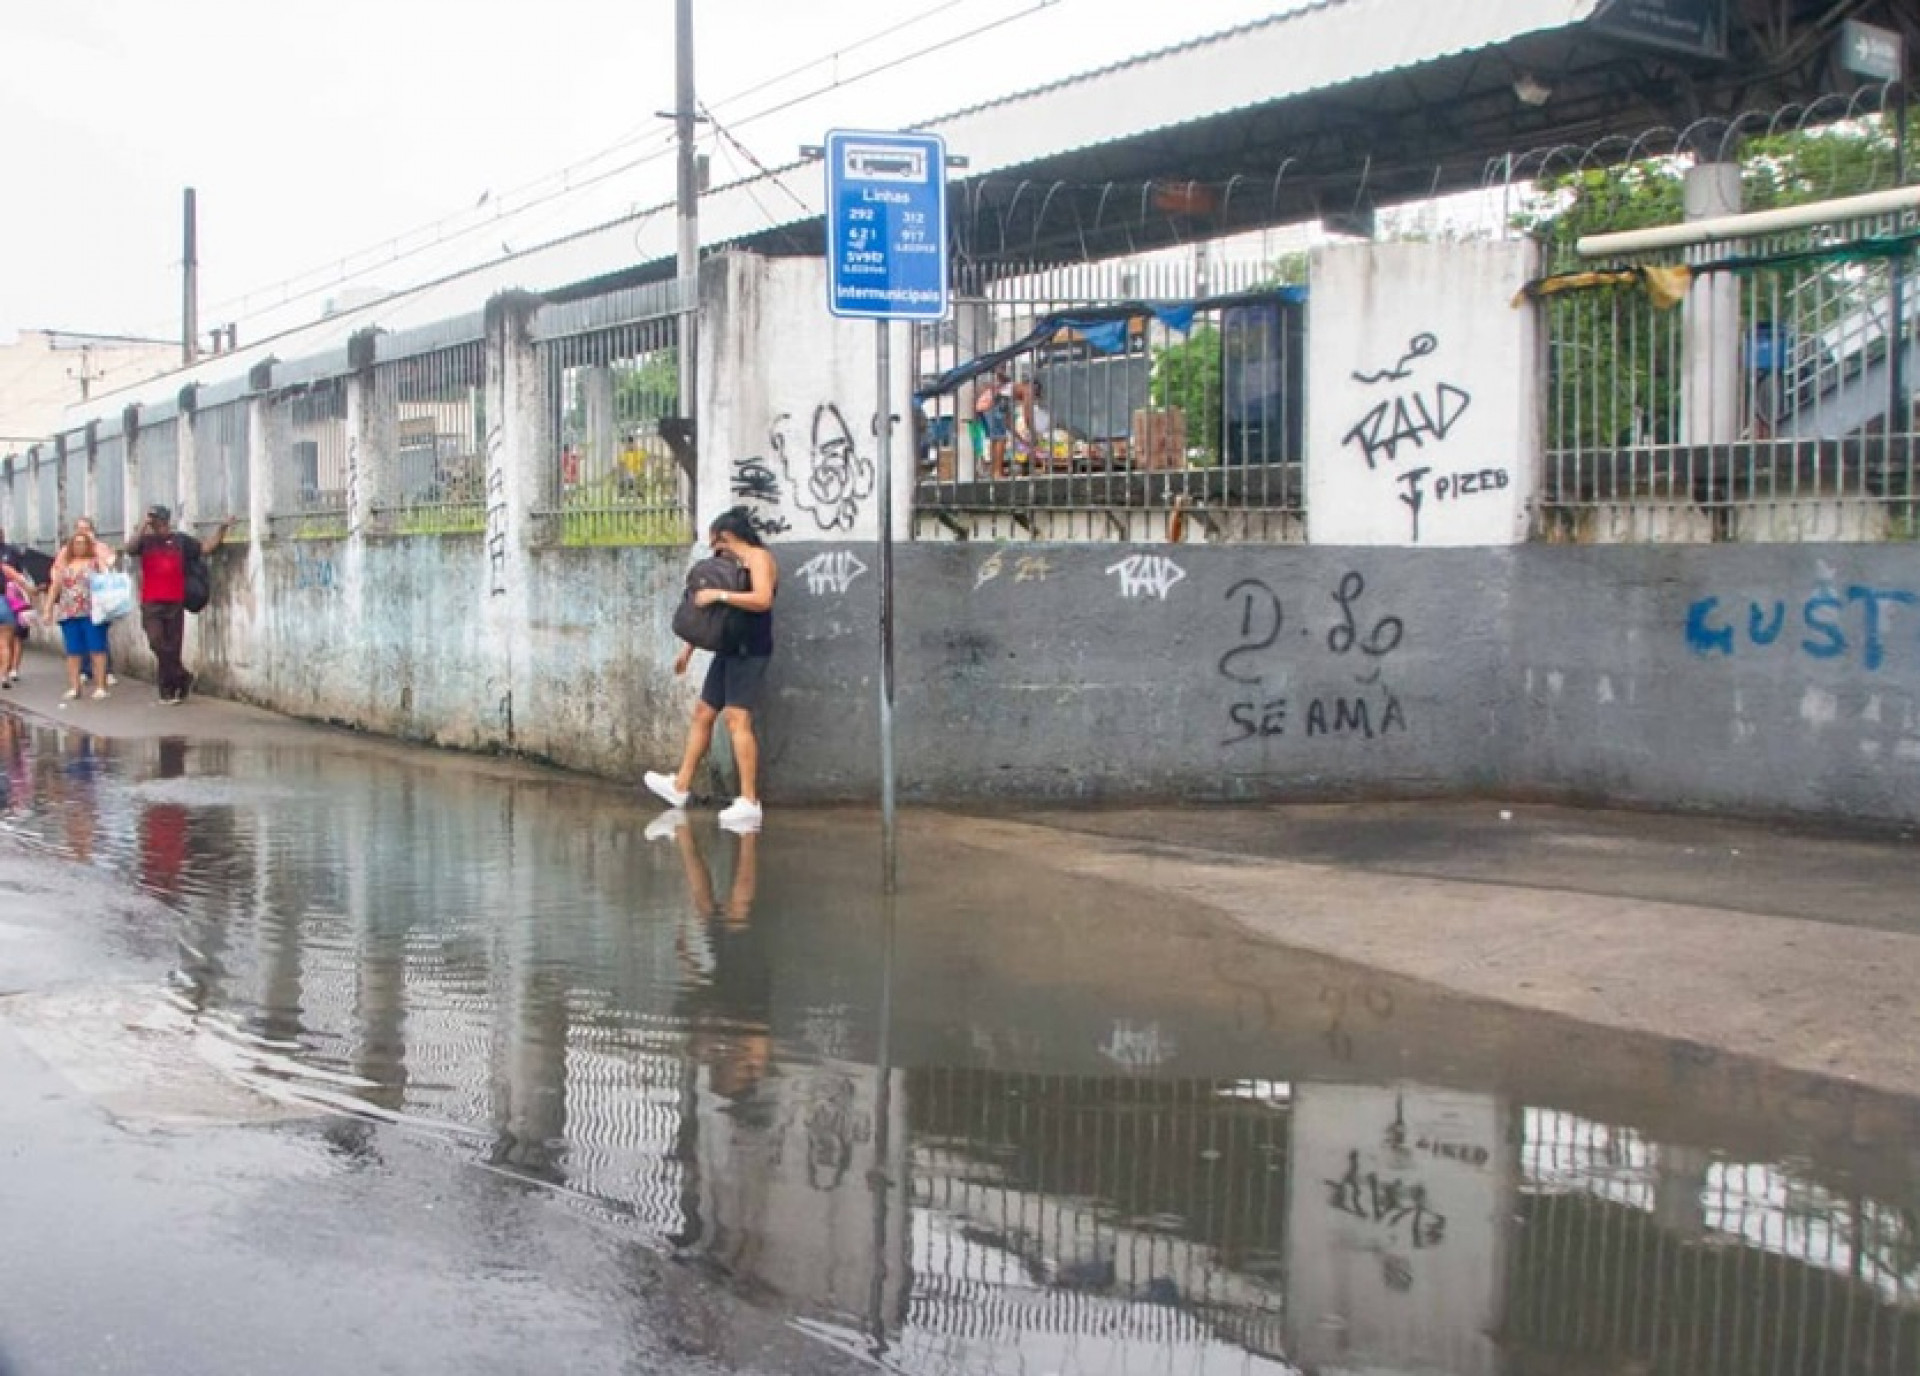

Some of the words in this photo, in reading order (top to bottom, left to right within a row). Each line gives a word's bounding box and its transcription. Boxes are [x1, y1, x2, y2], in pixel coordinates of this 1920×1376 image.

[863, 188, 910, 204] Linhas
[902, 211, 925, 224] 312
[837, 284, 940, 304] Intermunicipais
